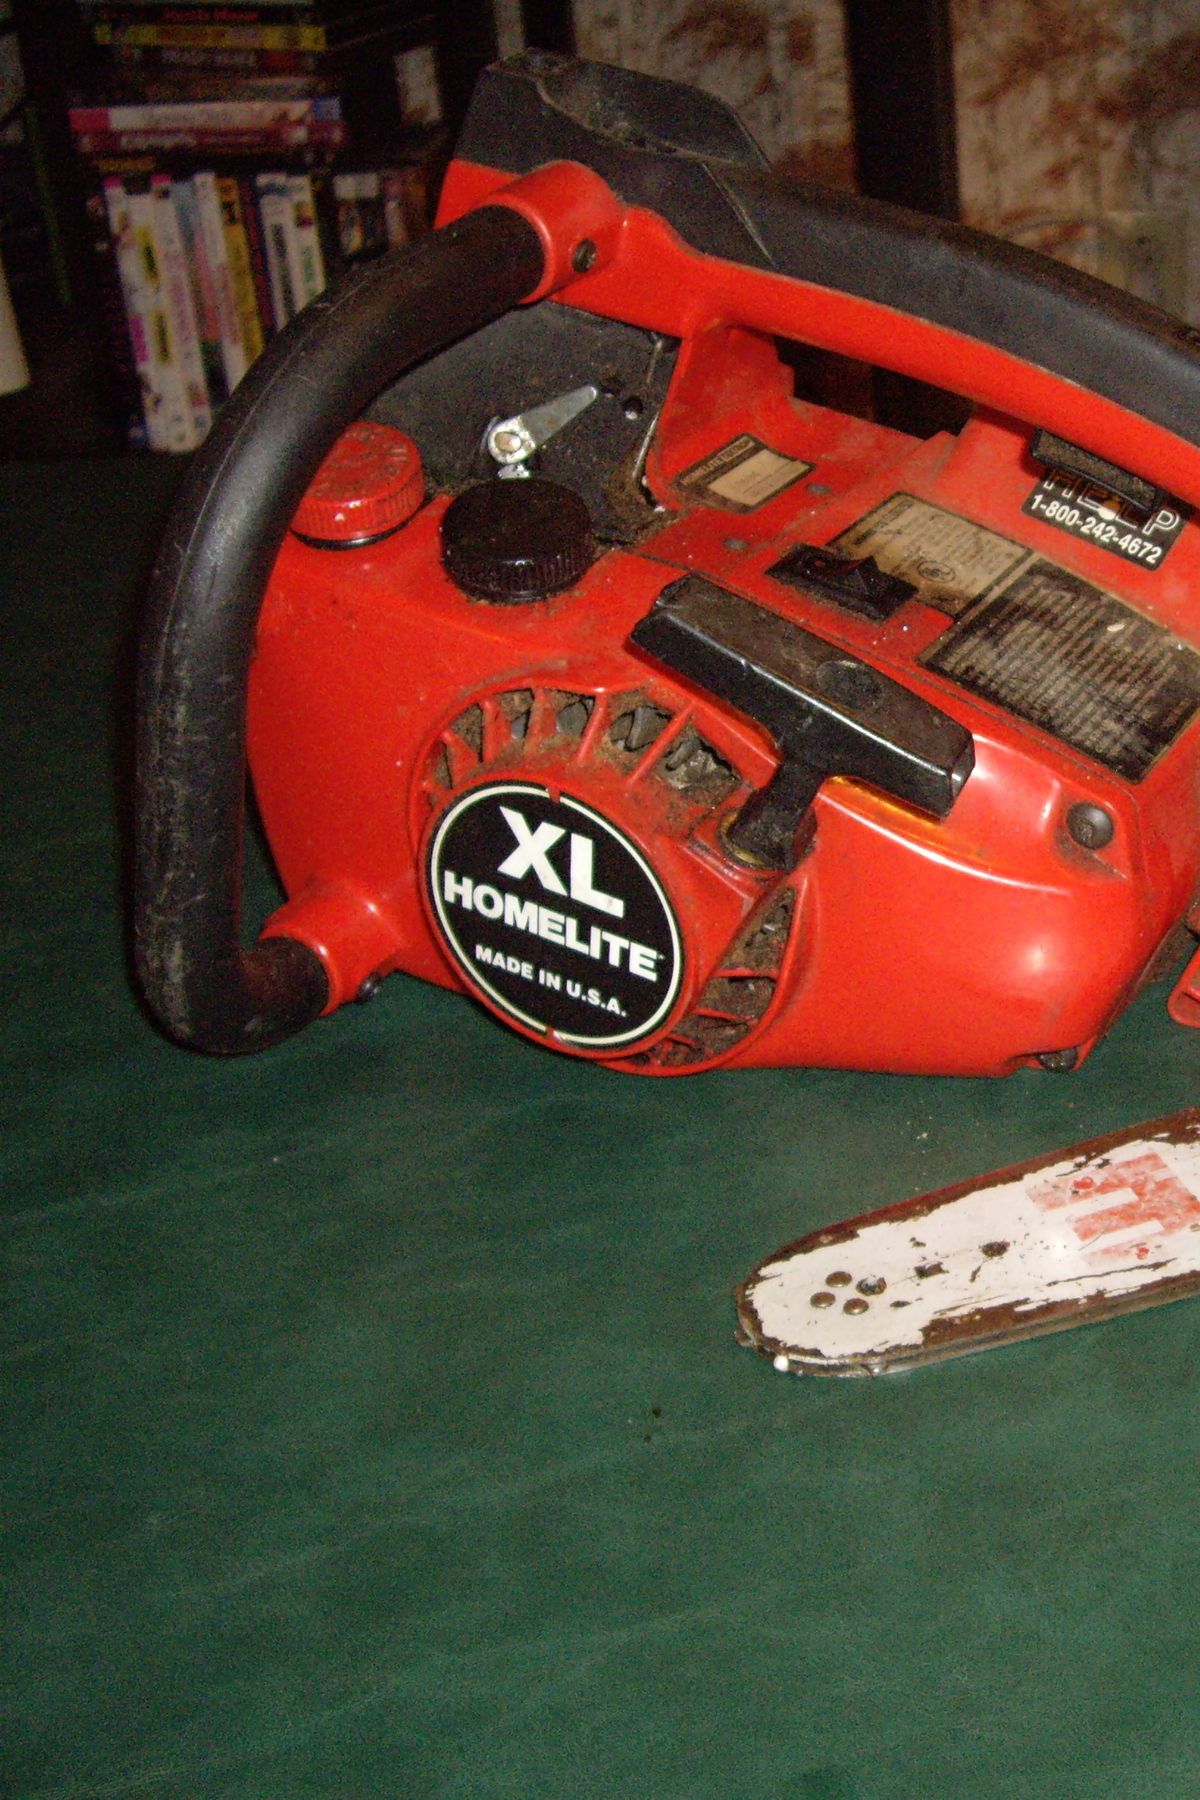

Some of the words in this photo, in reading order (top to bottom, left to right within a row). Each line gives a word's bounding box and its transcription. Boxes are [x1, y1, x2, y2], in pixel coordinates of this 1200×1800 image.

[1031, 494, 1162, 564] 1-800-242-4672
[497, 806, 624, 918] XL
[444, 870, 657, 982] HOMELITE
[475, 944, 533, 980] MADE
[539, 968, 561, 991] IN
[566, 979, 627, 1017] U.S.A.
